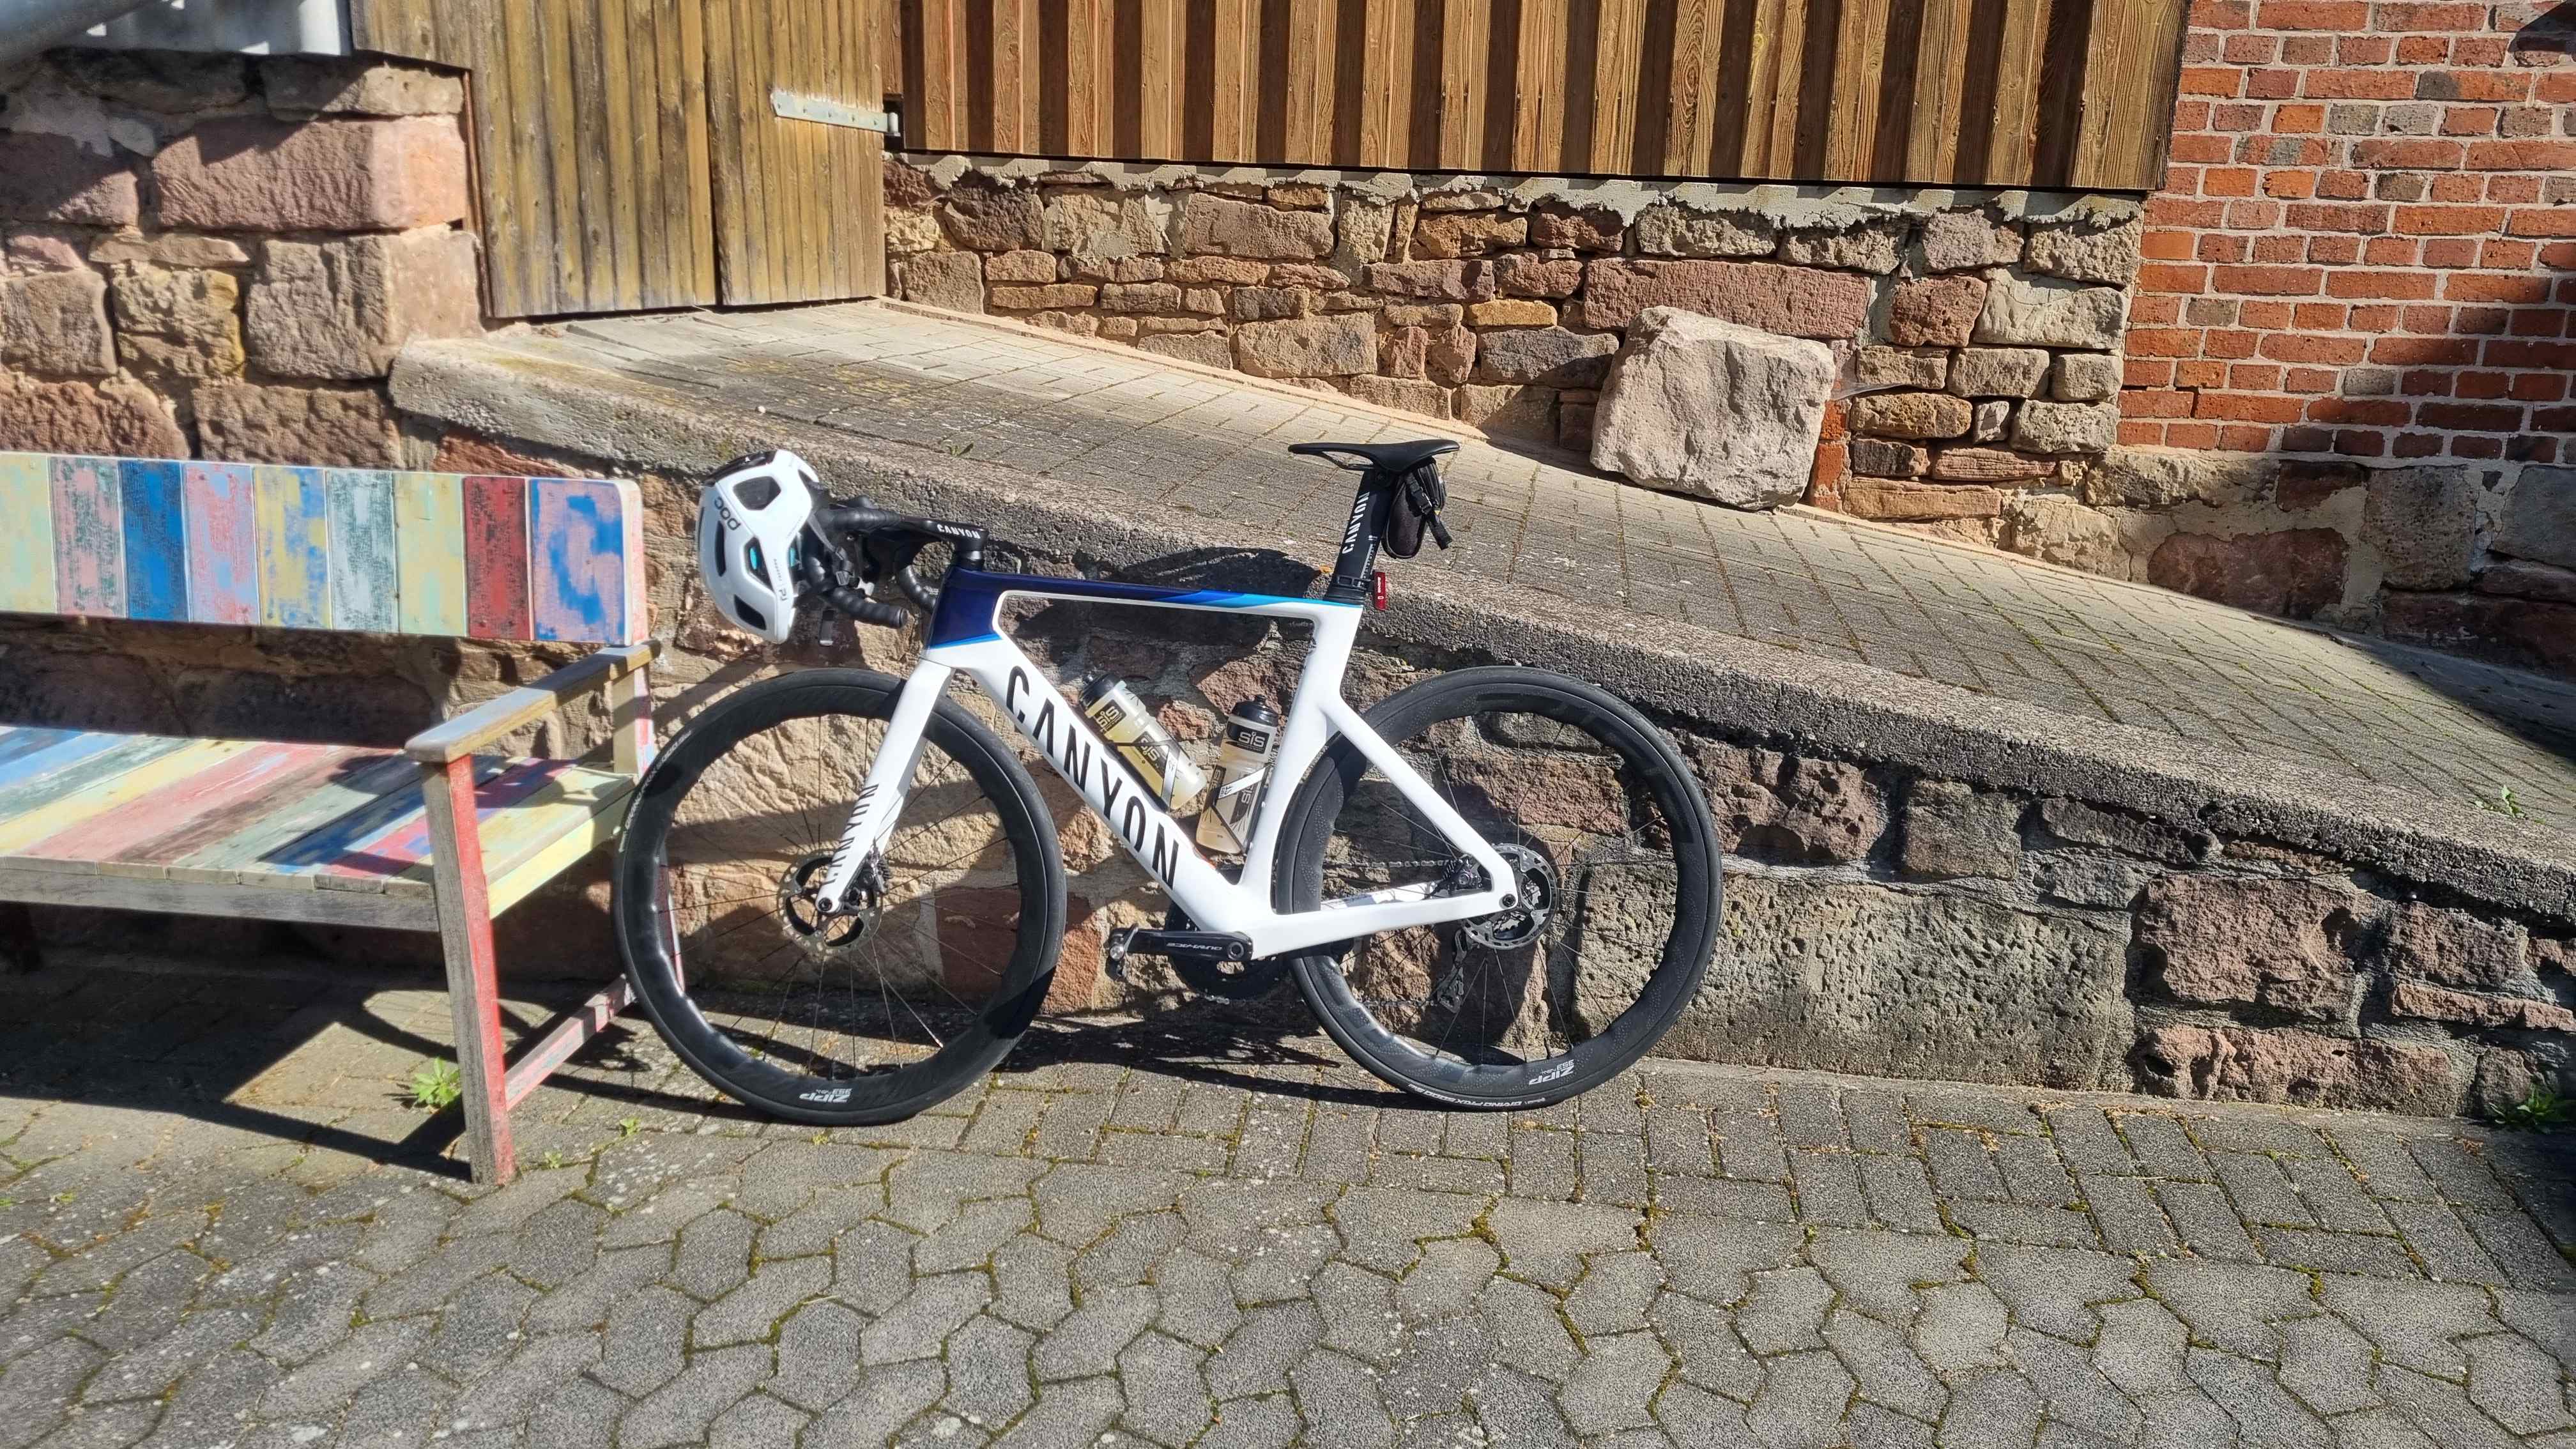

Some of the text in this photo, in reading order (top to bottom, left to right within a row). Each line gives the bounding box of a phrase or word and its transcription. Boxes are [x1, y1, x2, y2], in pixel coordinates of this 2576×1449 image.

[937, 524, 981, 539] CANYON
[1342, 491, 1370, 554] CANYON
[1006, 666, 1179, 890] CANYON
[1528, 1065, 1574, 1085] ZIPP
[799, 1092, 850, 1103] ZIPP
